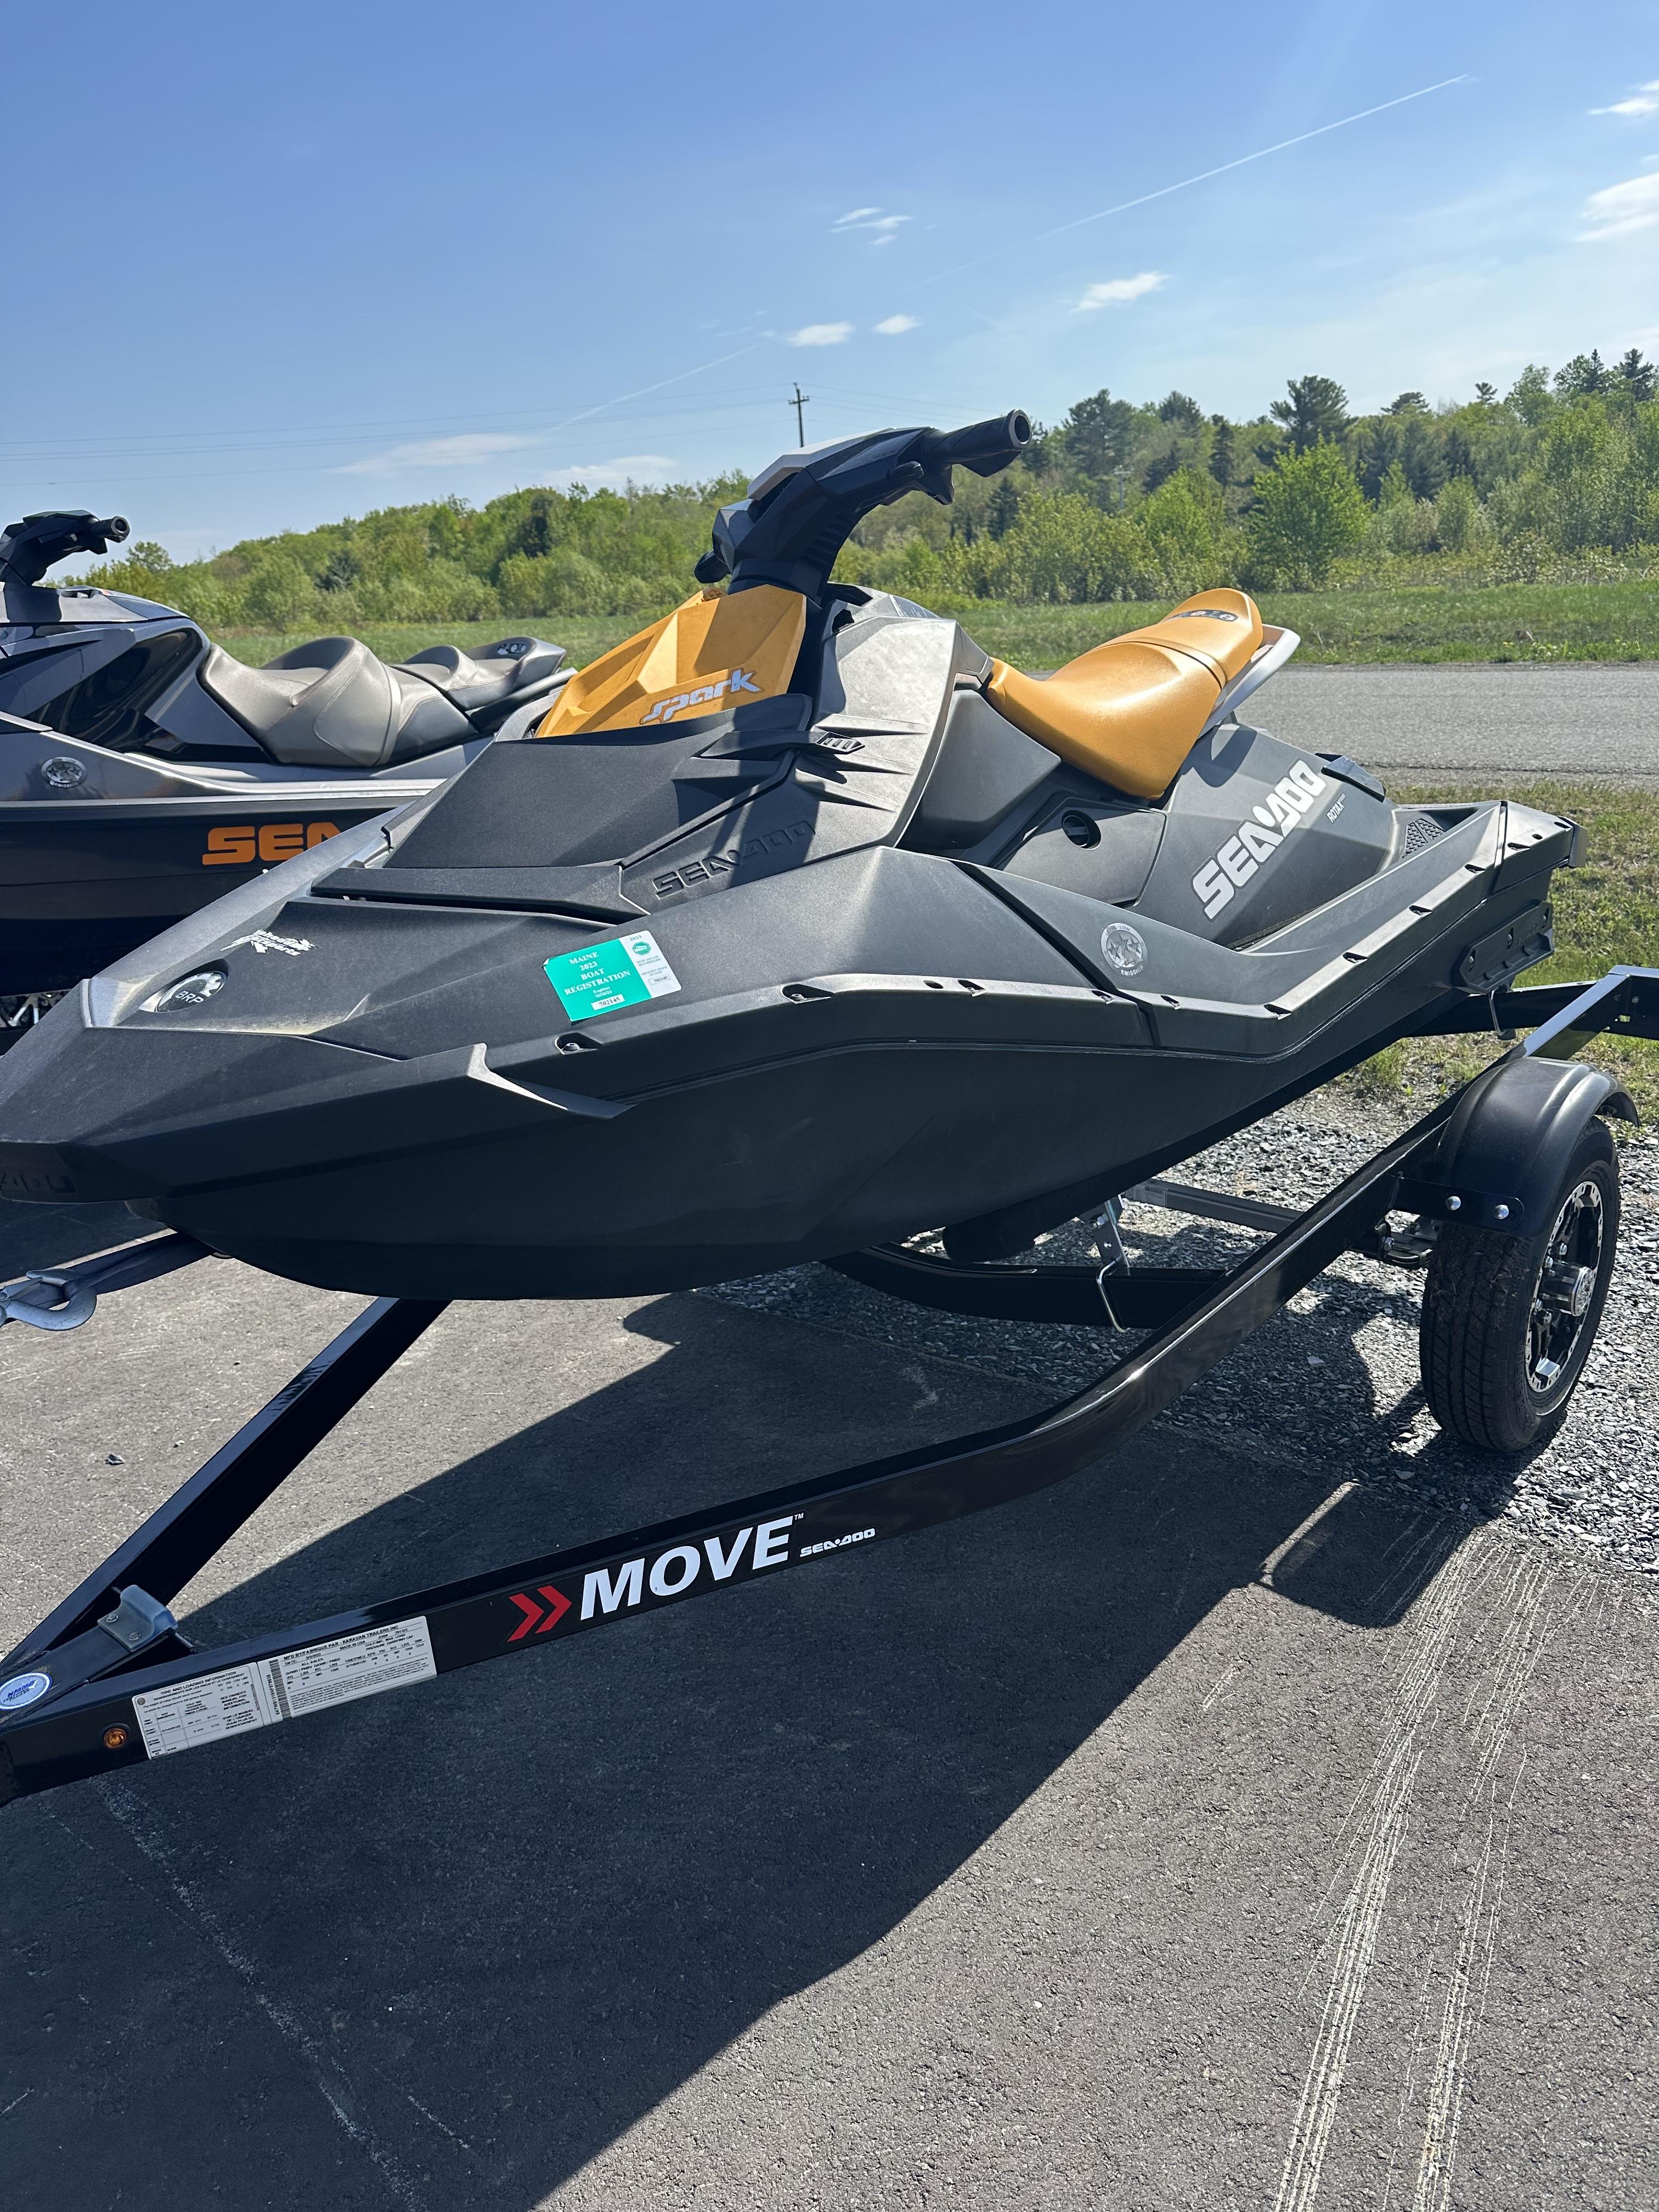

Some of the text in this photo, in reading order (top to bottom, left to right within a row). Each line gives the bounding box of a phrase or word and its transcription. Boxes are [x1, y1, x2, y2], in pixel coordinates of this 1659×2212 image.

[1327, 799, 1345, 823] ROTAX
[569, 951, 599, 965] MAINE
[579, 961, 598, 971] 2023
[580, 968, 605, 980] BOAT
[563, 969, 631, 995] REGISTRATION
[175, 990, 204, 1003] BRP
[599, 996, 621, 1007] 702145
[580, 1515, 793, 1621] MOVE
[342, 1634, 365, 1644] KARAVAN
[366, 1628, 389, 1637] TRAILERS
[183, 1679, 204, 1689] LOADING
[205, 1671, 236, 1683] INFORMATION
